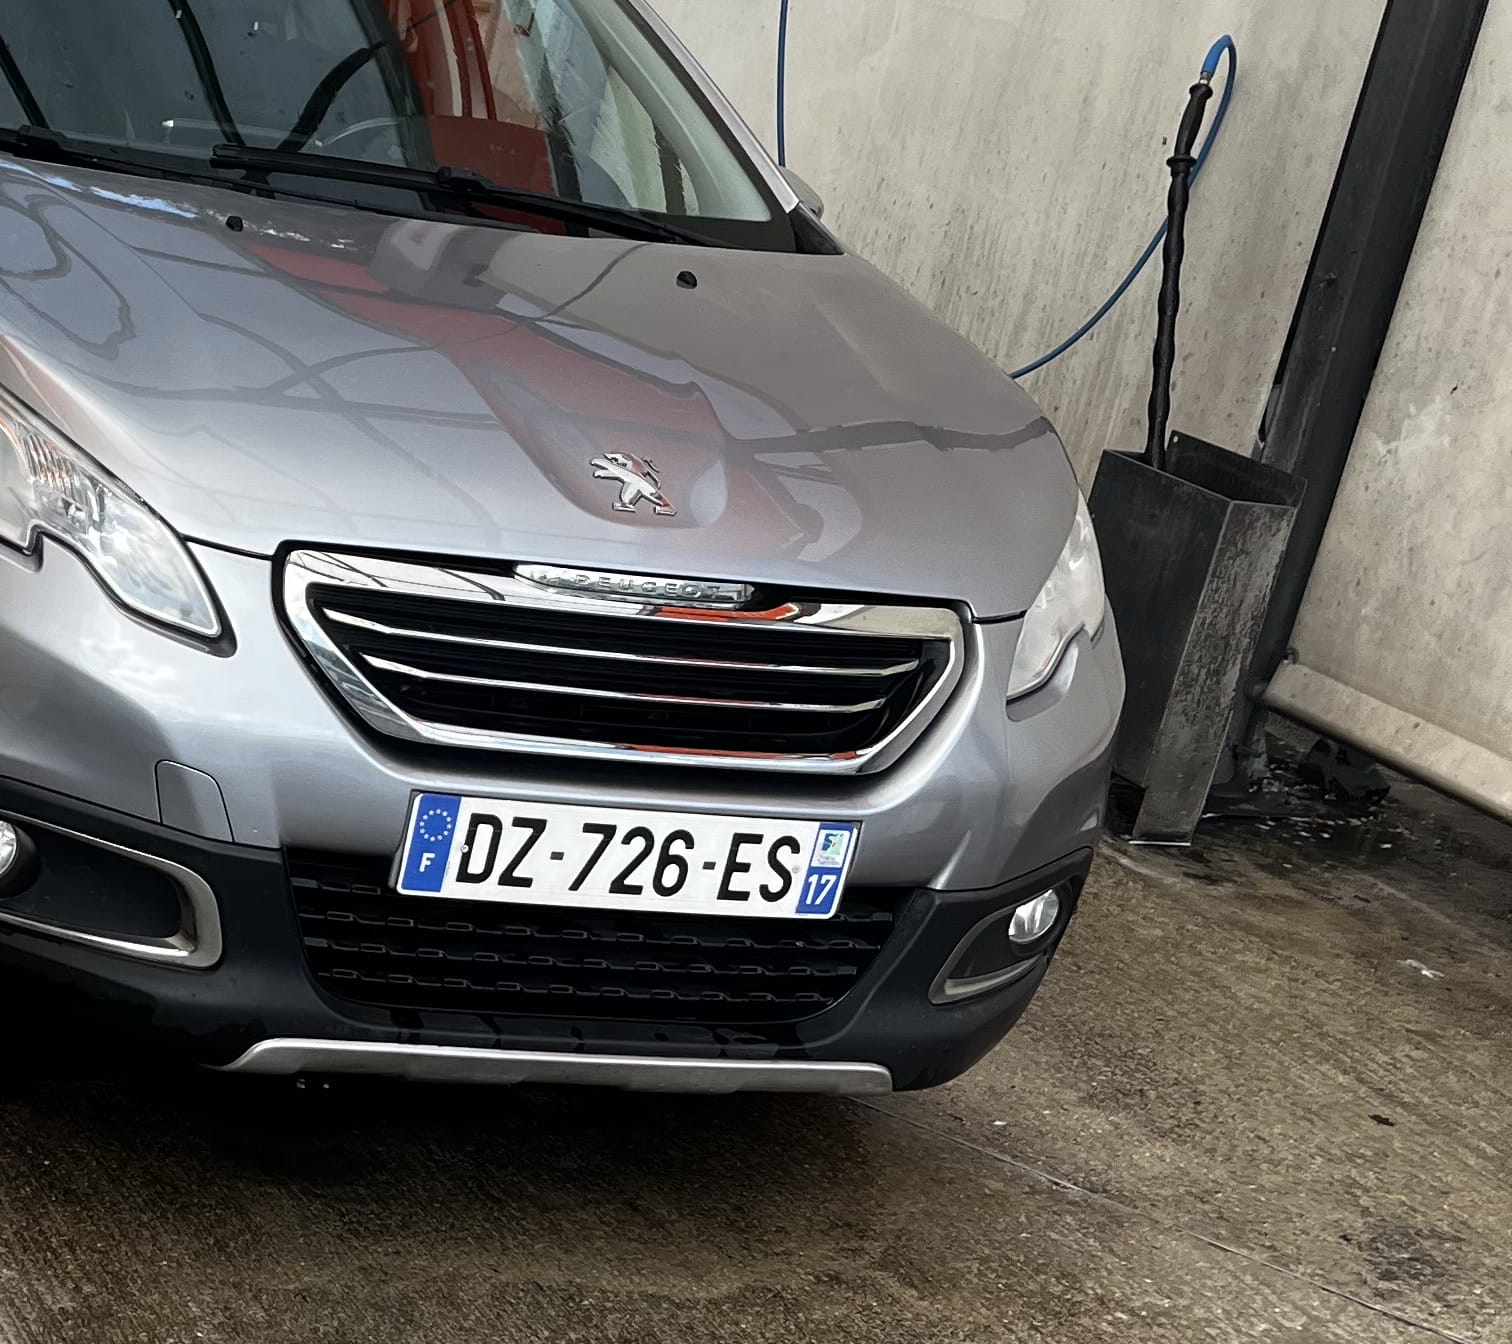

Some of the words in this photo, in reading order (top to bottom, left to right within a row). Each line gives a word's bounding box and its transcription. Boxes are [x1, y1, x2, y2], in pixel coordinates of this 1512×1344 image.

[572, 573, 721, 599] PEUGEOT
[419, 852, 436, 872] F
[455, 812, 801, 903] DZ-726-ES
[805, 873, 838, 905] 17
